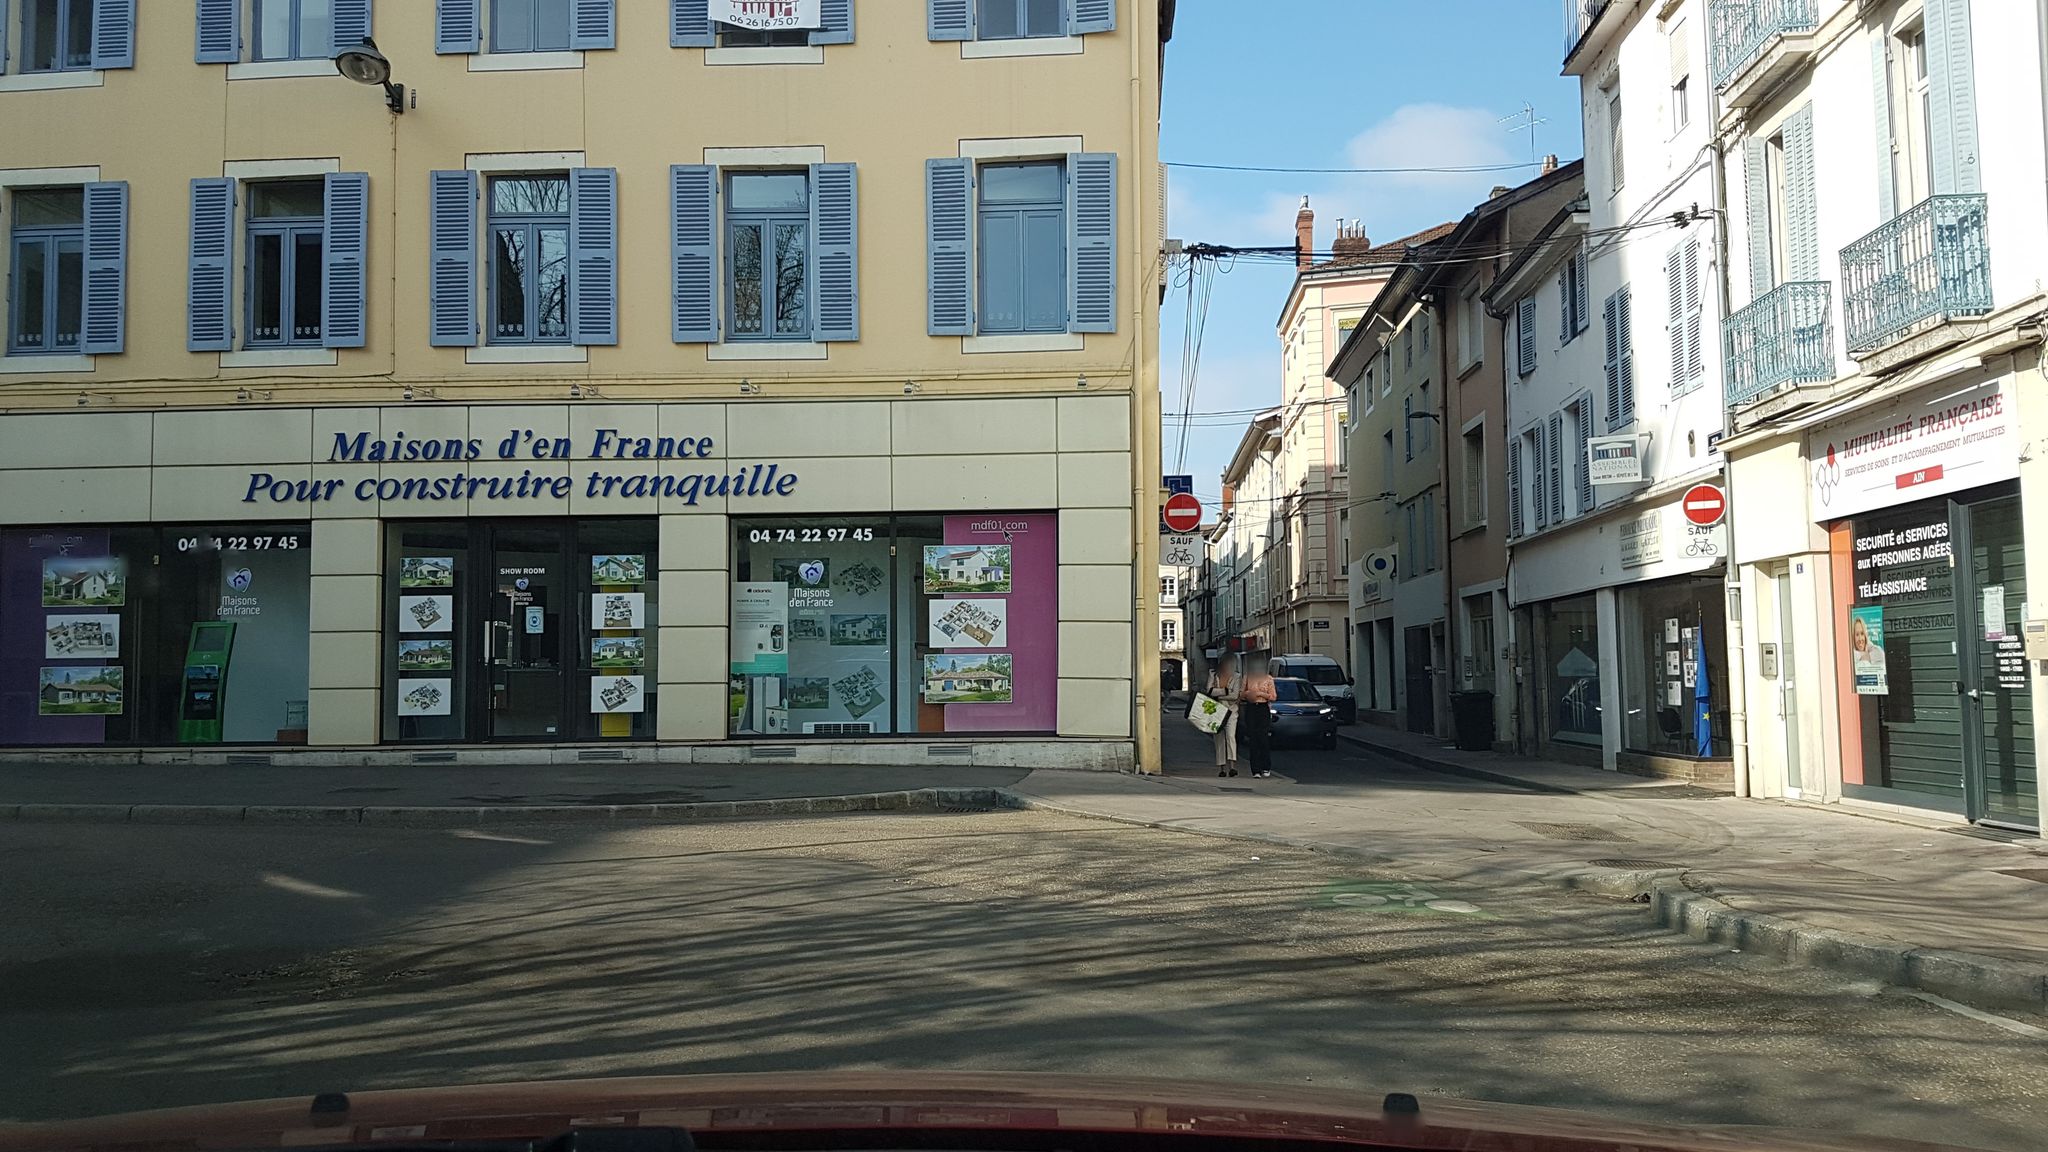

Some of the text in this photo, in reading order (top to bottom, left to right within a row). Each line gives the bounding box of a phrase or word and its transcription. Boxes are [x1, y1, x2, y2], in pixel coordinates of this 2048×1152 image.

[730, 15, 799, 27] 06 26 16 75 07
[1844, 393, 2003, 459] MUTUALITÉ FRANÇAISE
[327, 429, 714, 462] Maisons d'en France
[241, 463, 798, 506] Pour construire tranquille
[971, 520, 1028, 530] mdf01.com
[1687, 526, 1714, 536] SAUF
[750, 528, 873, 542] 04 74 22 97 45
[1170, 537, 1194, 545] SAUF
[1856, 522, 1948, 552] SECURITÉ et SERVICES
[228, 537, 247, 550] 22
[253, 537, 273, 550] 97
[278, 537, 298, 550] 45
[1857, 541, 1951, 570] aux PERSONNES AGÉES
[793, 588, 830, 598] Maisons
[1859, 577, 1927, 598] TÉLÉASSISTANCE
[221, 595, 257, 606] Maisons
[806, 597, 834, 607] France
[234, 606, 260, 615] France
